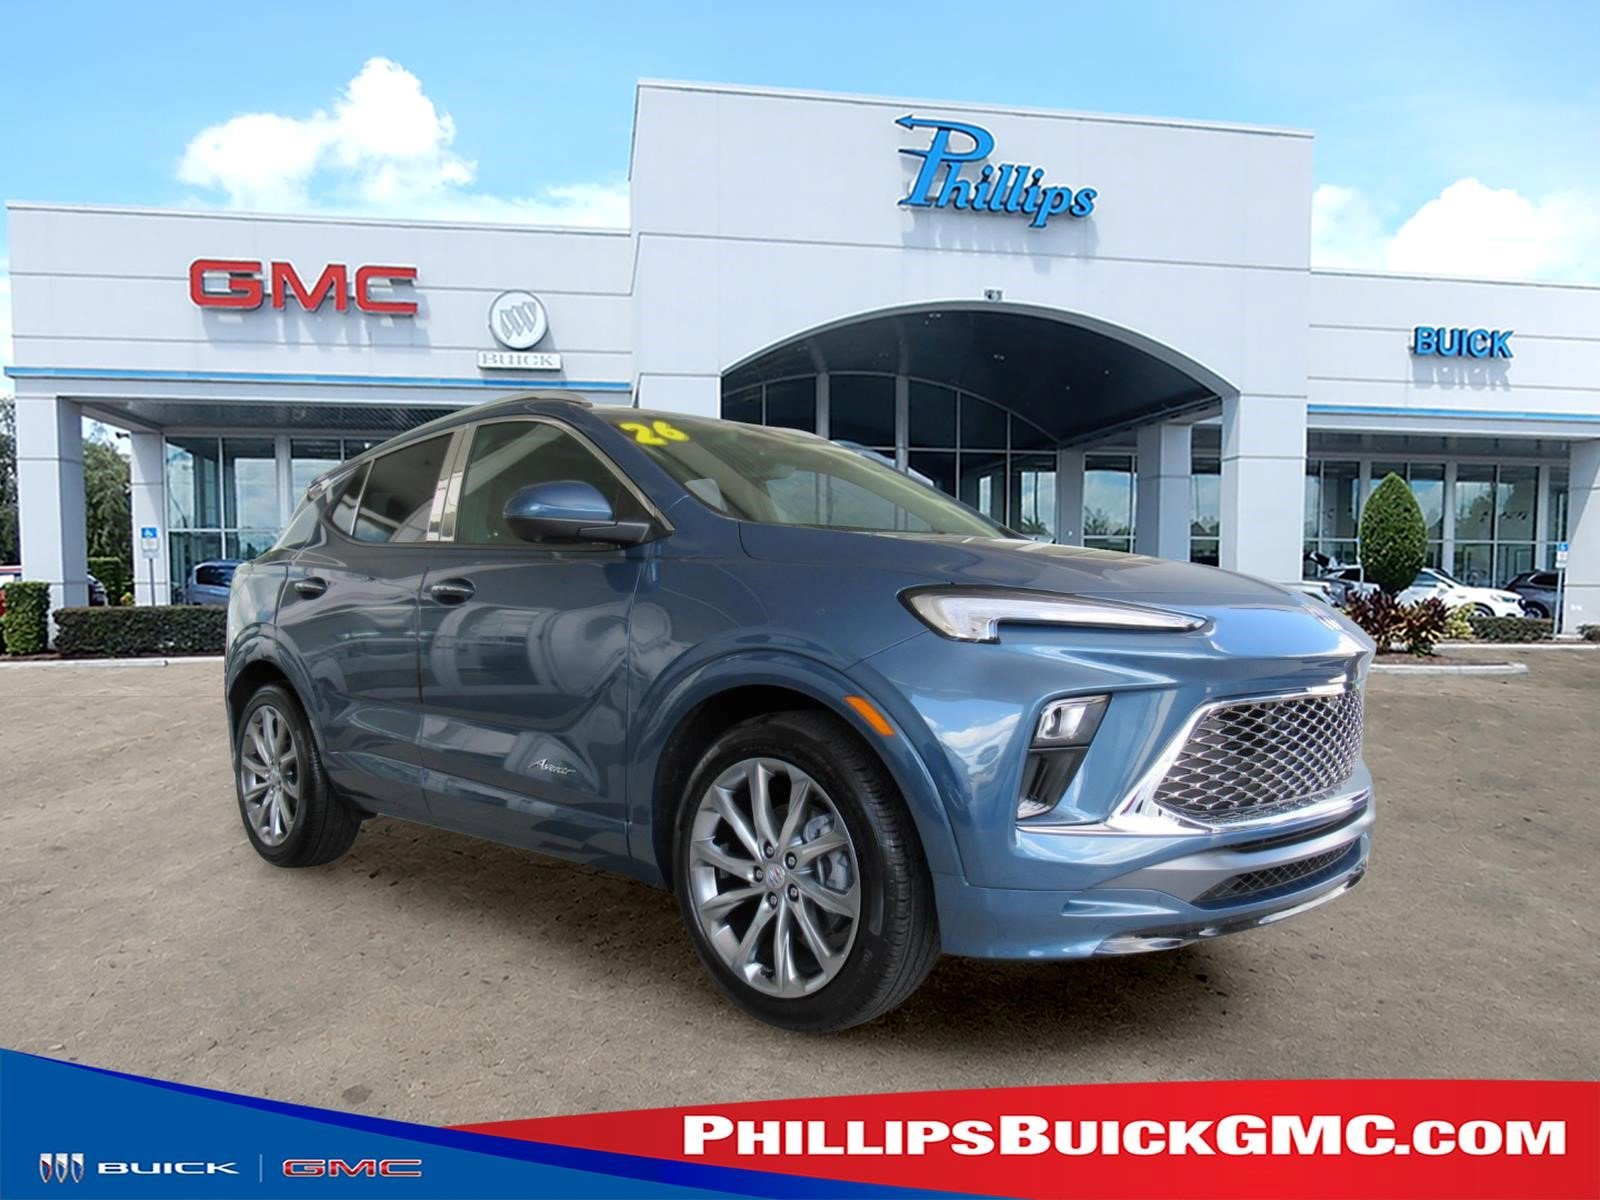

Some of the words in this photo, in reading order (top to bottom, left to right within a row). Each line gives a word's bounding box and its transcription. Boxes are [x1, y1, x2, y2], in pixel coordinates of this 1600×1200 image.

[895, 114, 1098, 229] Phillips
[189, 258, 419, 316] GMC
[481, 352, 555, 368] BUICK
[1412, 325, 1514, 360] BUICK
[619, 420, 690, 447] 26
